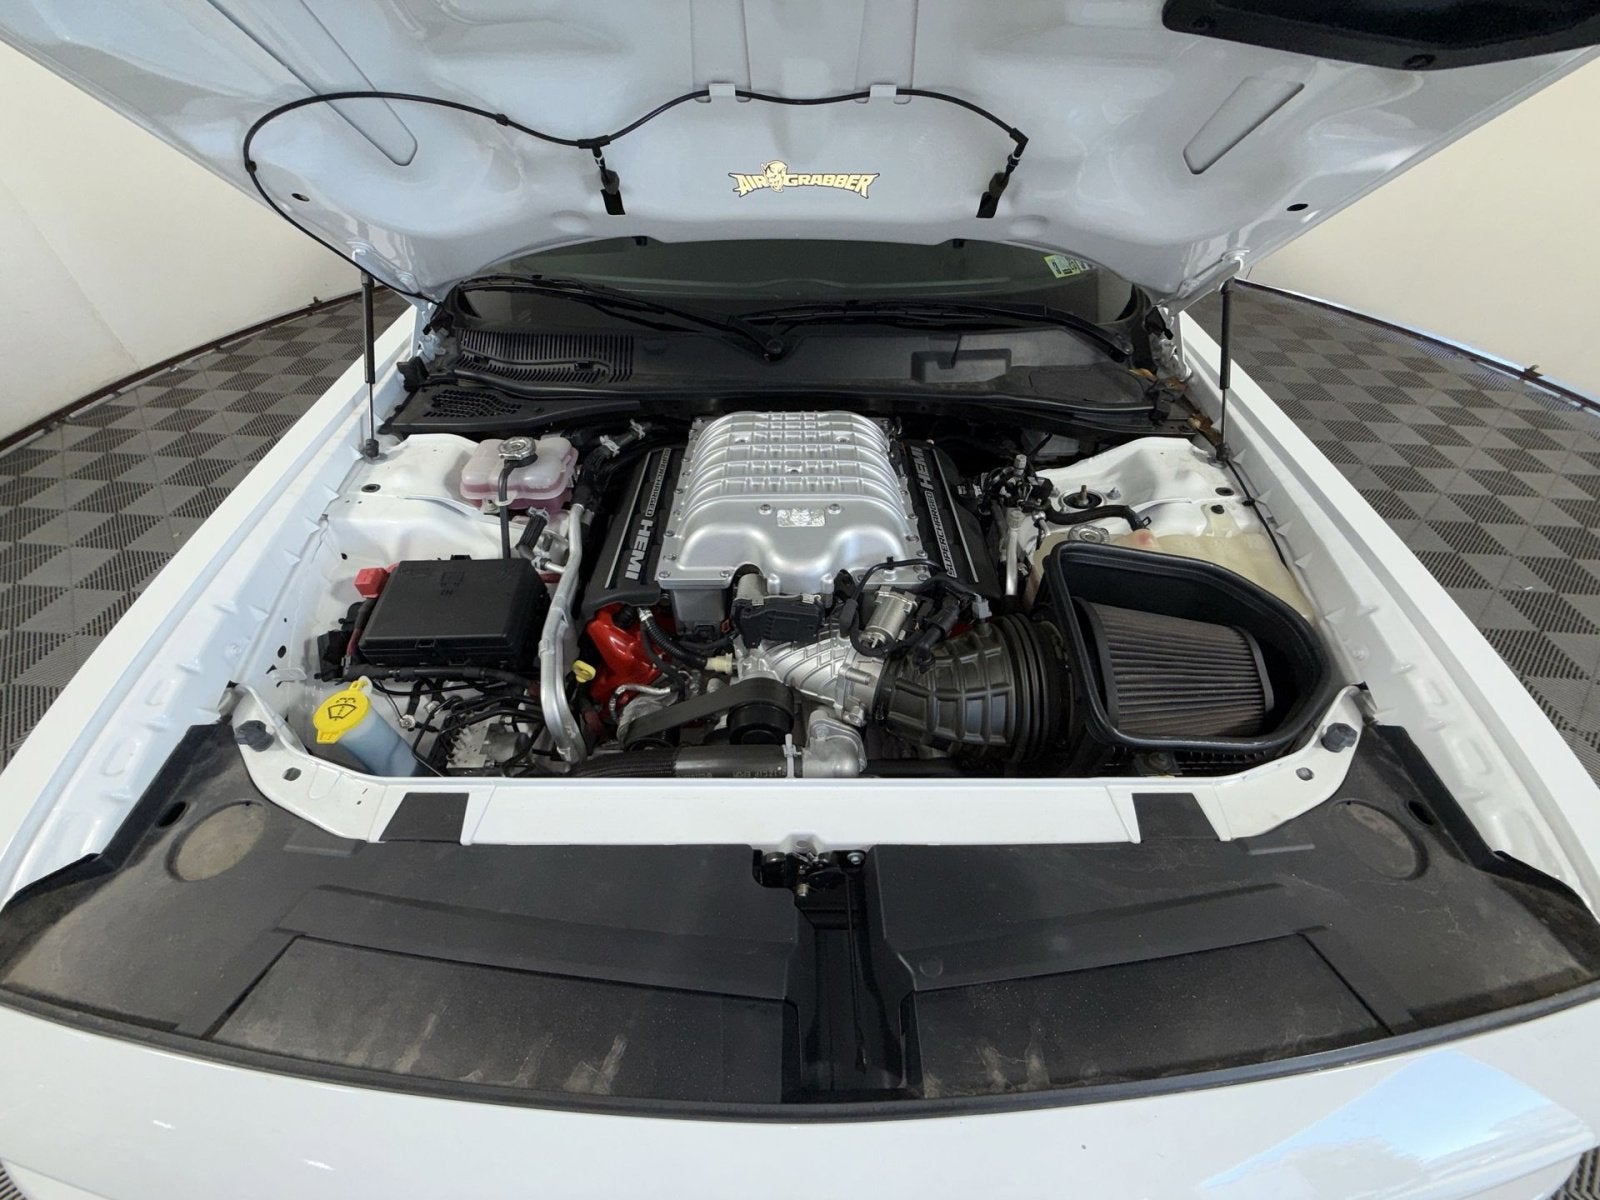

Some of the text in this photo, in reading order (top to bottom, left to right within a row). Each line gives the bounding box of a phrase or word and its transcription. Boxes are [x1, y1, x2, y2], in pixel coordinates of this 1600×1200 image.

[728, 173, 880, 199] AIR GRABBER
[625, 448, 671, 580] SUPERCHARGED HEMI
[911, 446, 957, 578] SUPERCHARGED HEMI
